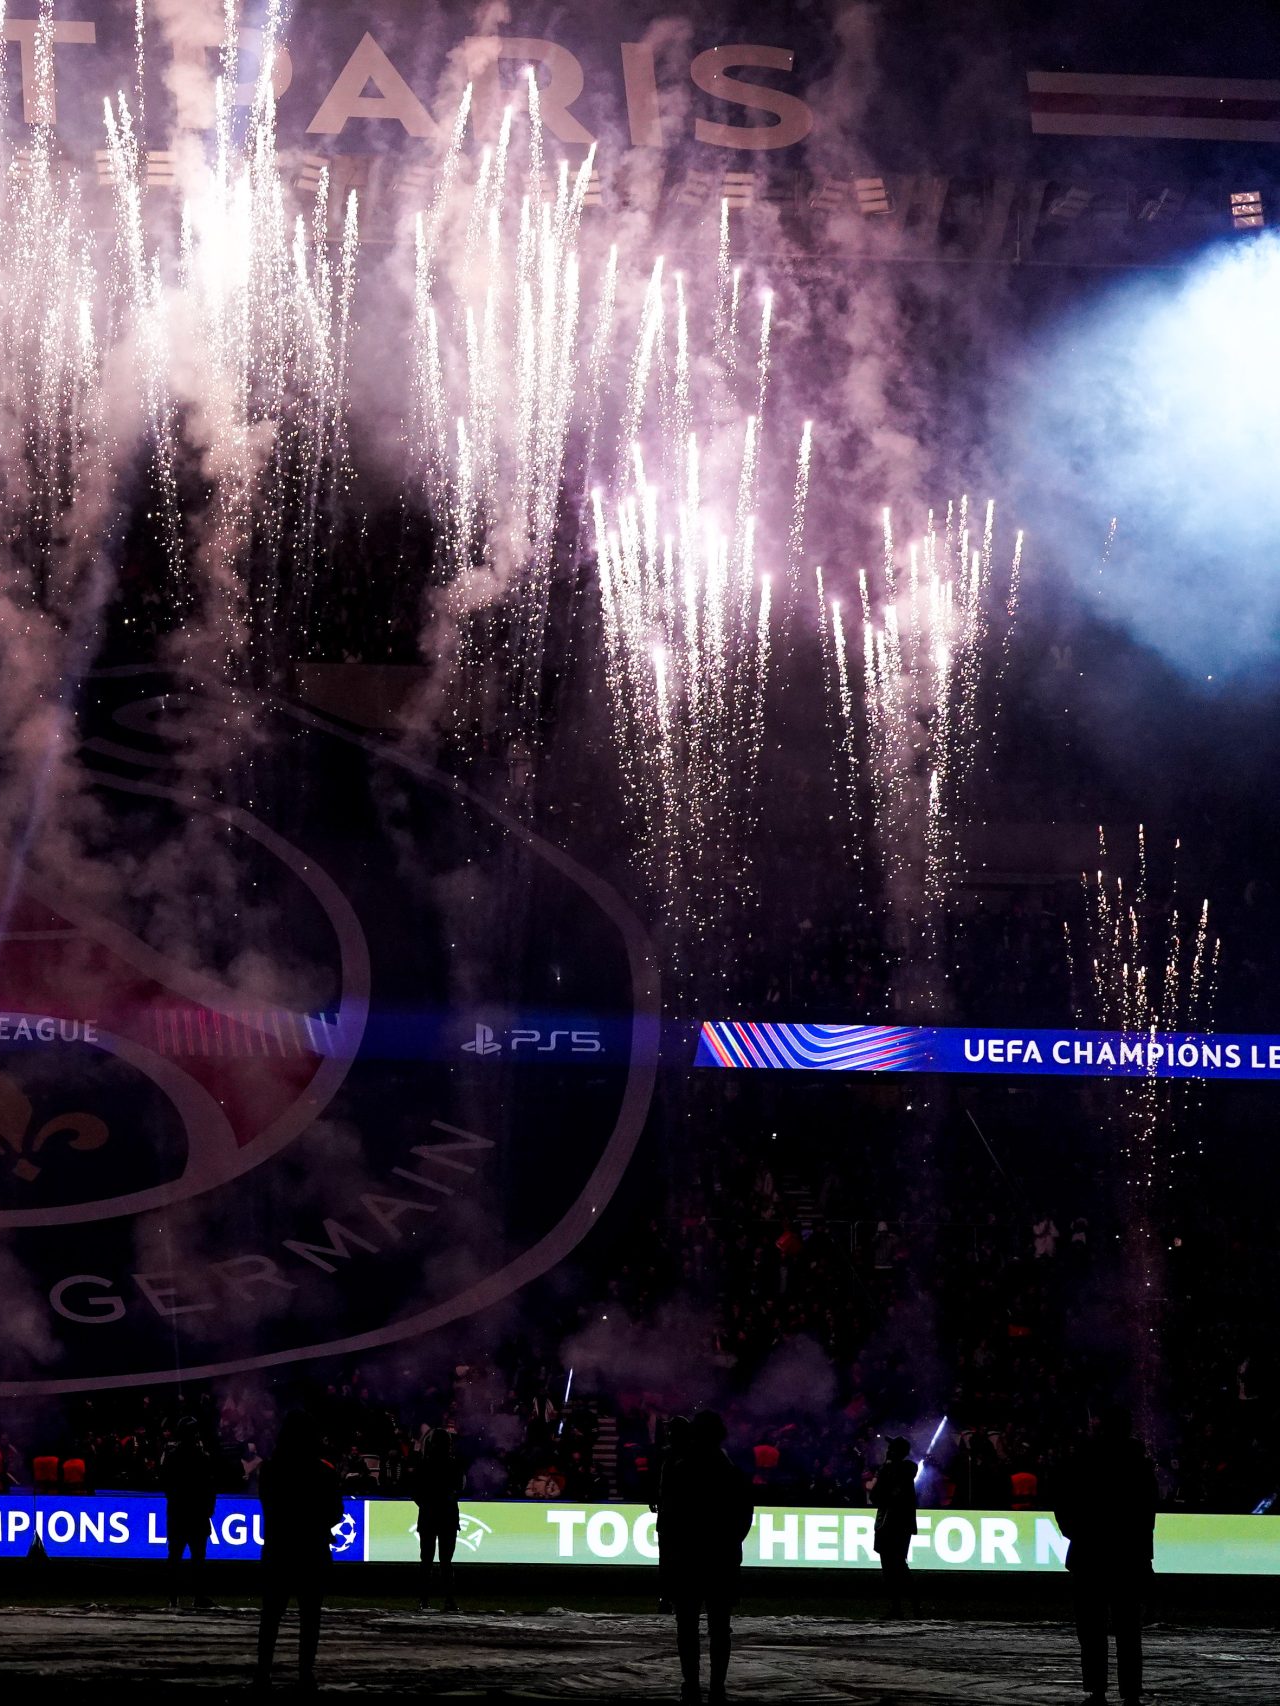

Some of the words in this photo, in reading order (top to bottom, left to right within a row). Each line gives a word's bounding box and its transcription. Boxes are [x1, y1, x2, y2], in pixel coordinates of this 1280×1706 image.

[172, 27, 813, 150] PARIS
[964, 1039, 1043, 1063] UEFA
[1052, 1040, 1241, 1068] CHAMPIONS
[48, 1119, 496, 1326] GERMAIN
[148, 1512, 265, 1546] LGU
[547, 1510, 881, 1562] TOGHER
[908, 1515, 1021, 1564] FOR
